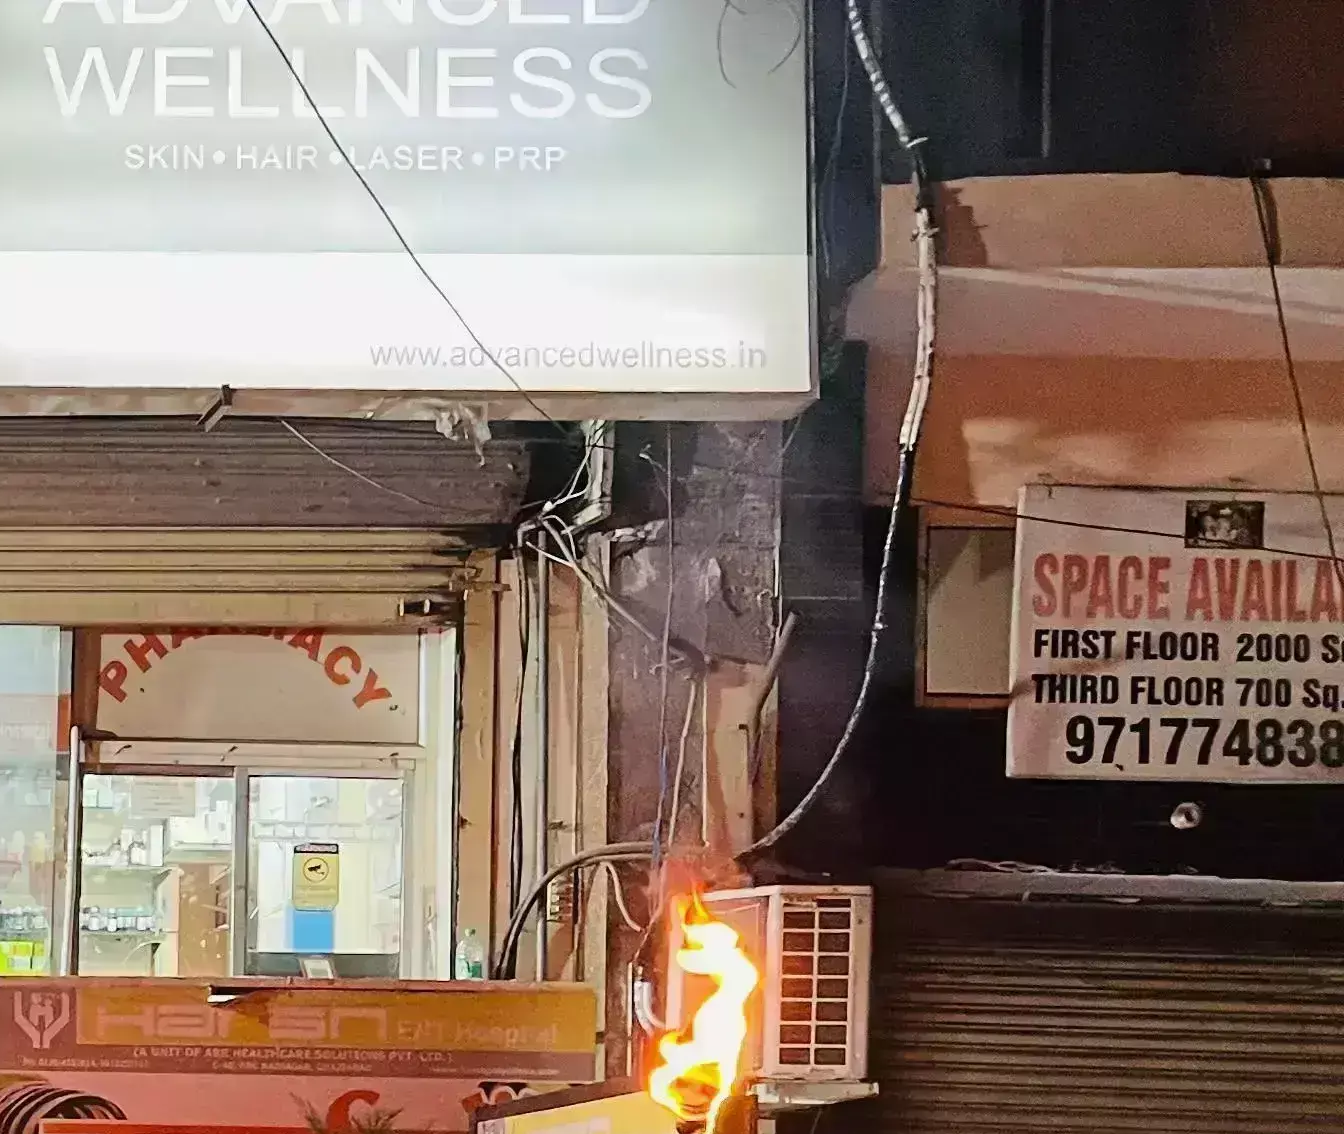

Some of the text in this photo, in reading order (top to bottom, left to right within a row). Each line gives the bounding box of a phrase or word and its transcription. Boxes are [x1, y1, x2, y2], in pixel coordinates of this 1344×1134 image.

[44, 46, 653, 121] WELLNESS
[123, 144, 567, 172] SKIN HAIR LASER PRP
[369, 341, 767, 369] www.advancedwellness.in
[1032, 553, 1344, 623] SPACE AVAILA
[1033, 629, 1310, 664] FIRST FLOOR 2000
[1031, 674, 1119, 705] THIRD
[1130, 676, 1224, 707] FLOOR
[1235, 678, 1292, 708] 700
